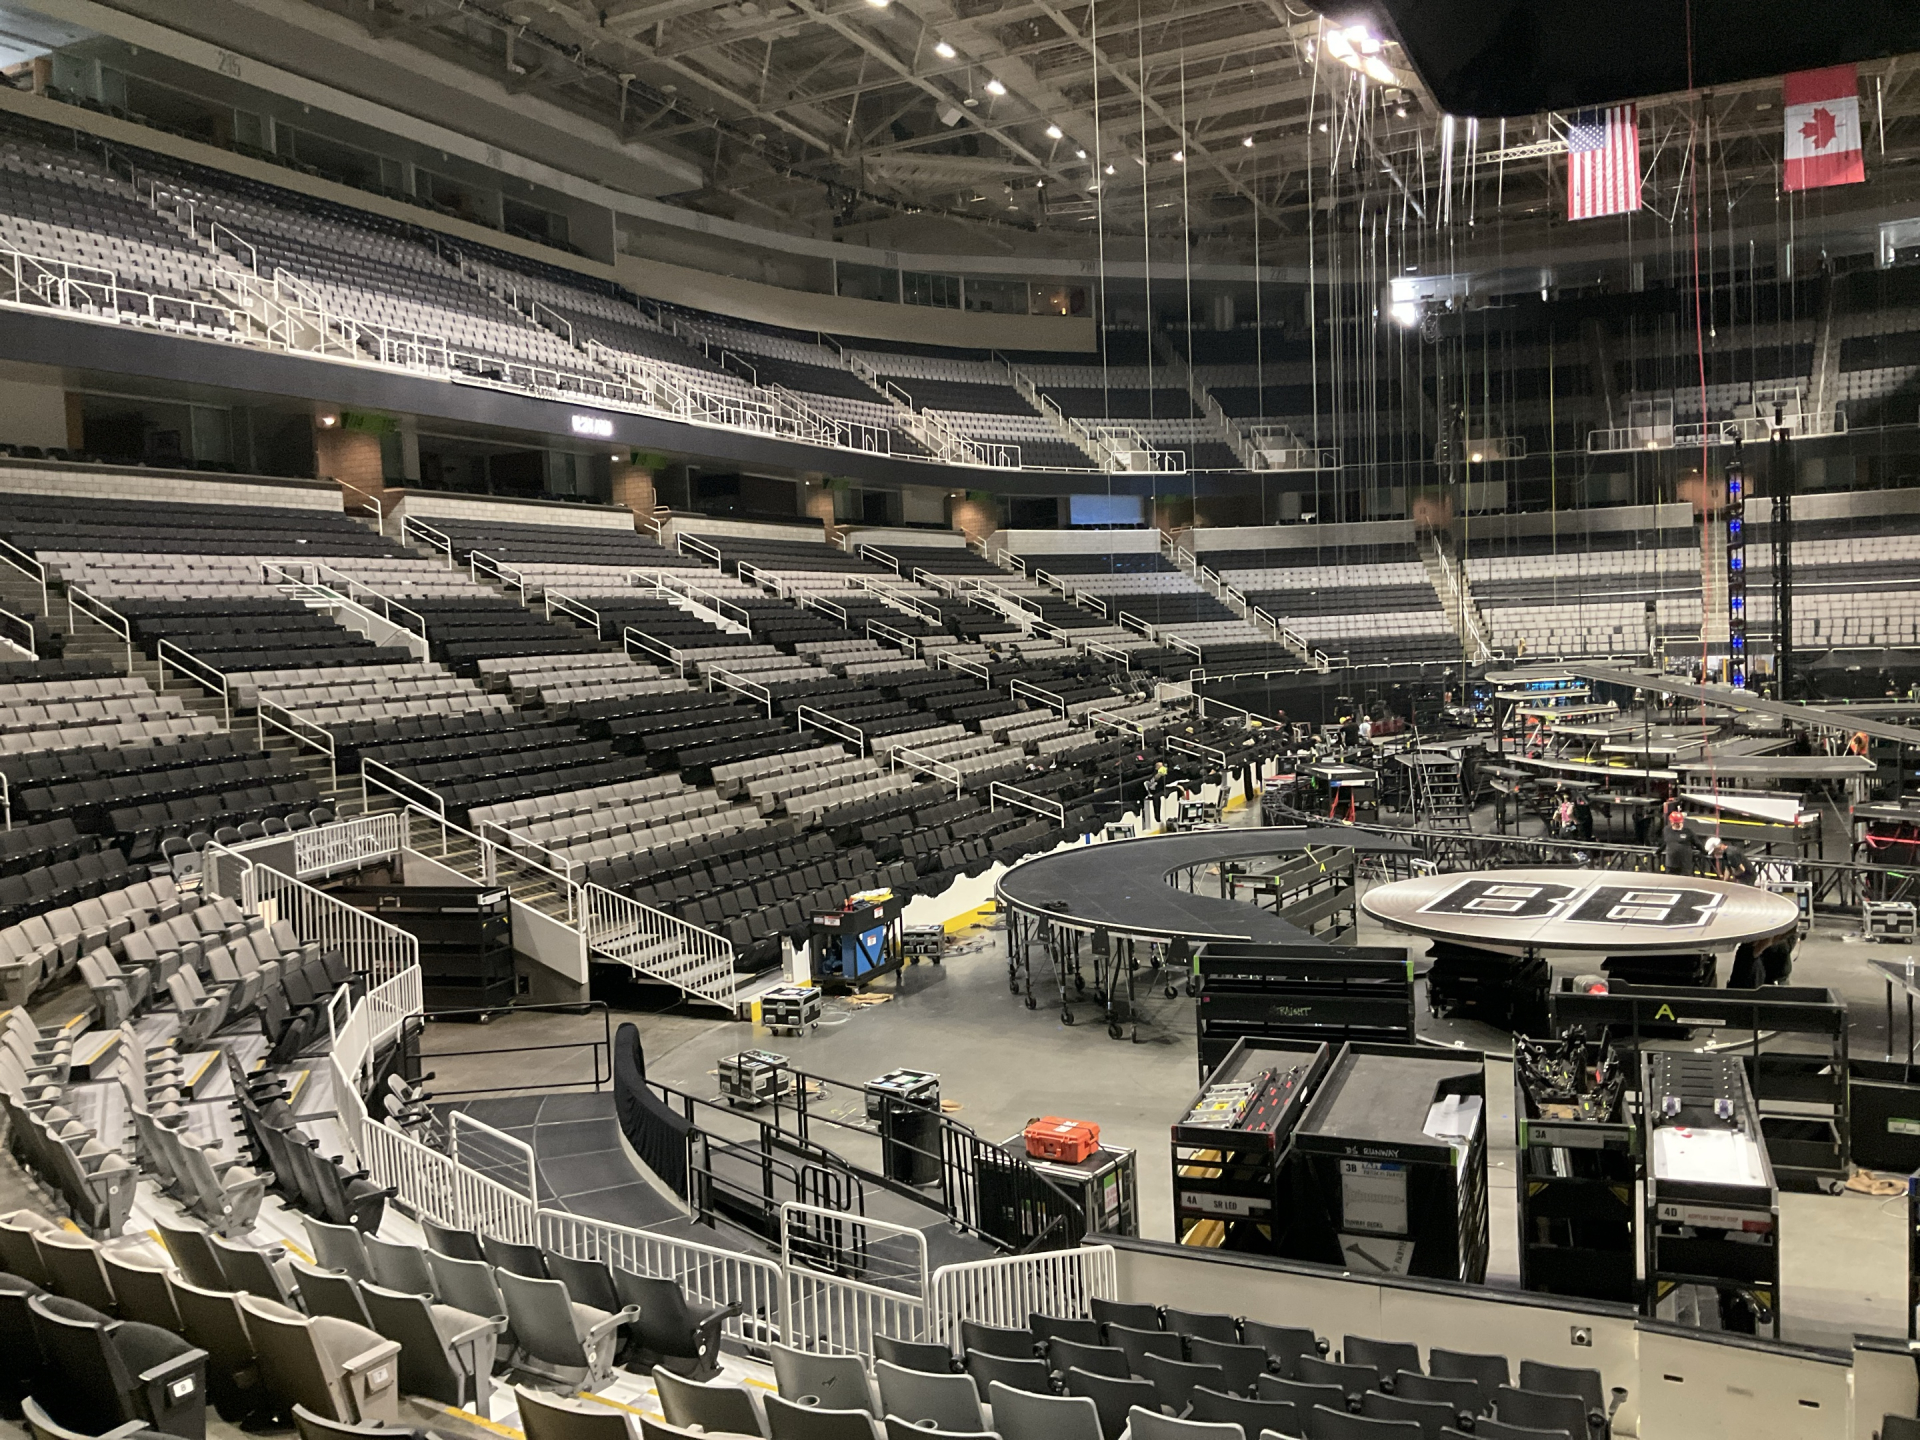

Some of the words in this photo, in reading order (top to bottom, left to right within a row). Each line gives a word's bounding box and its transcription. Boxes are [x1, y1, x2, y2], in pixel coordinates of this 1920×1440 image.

[1320, 863, 1326, 873] A
[1415, 878, 1727, 928] BB
[1655, 1003, 1675, 1020] A
[1535, 1130, 1546, 1139] 3A
[1363, 1148, 1400, 1158] RUNWAY
[1346, 1163, 1357, 1173] 3B
[1187, 1196, 1197, 1205] 4A
[1213, 1200, 1223, 1209] SR
[1225, 1201, 1237, 1210] LED
[1664, 1207, 1677, 1217] 4D
